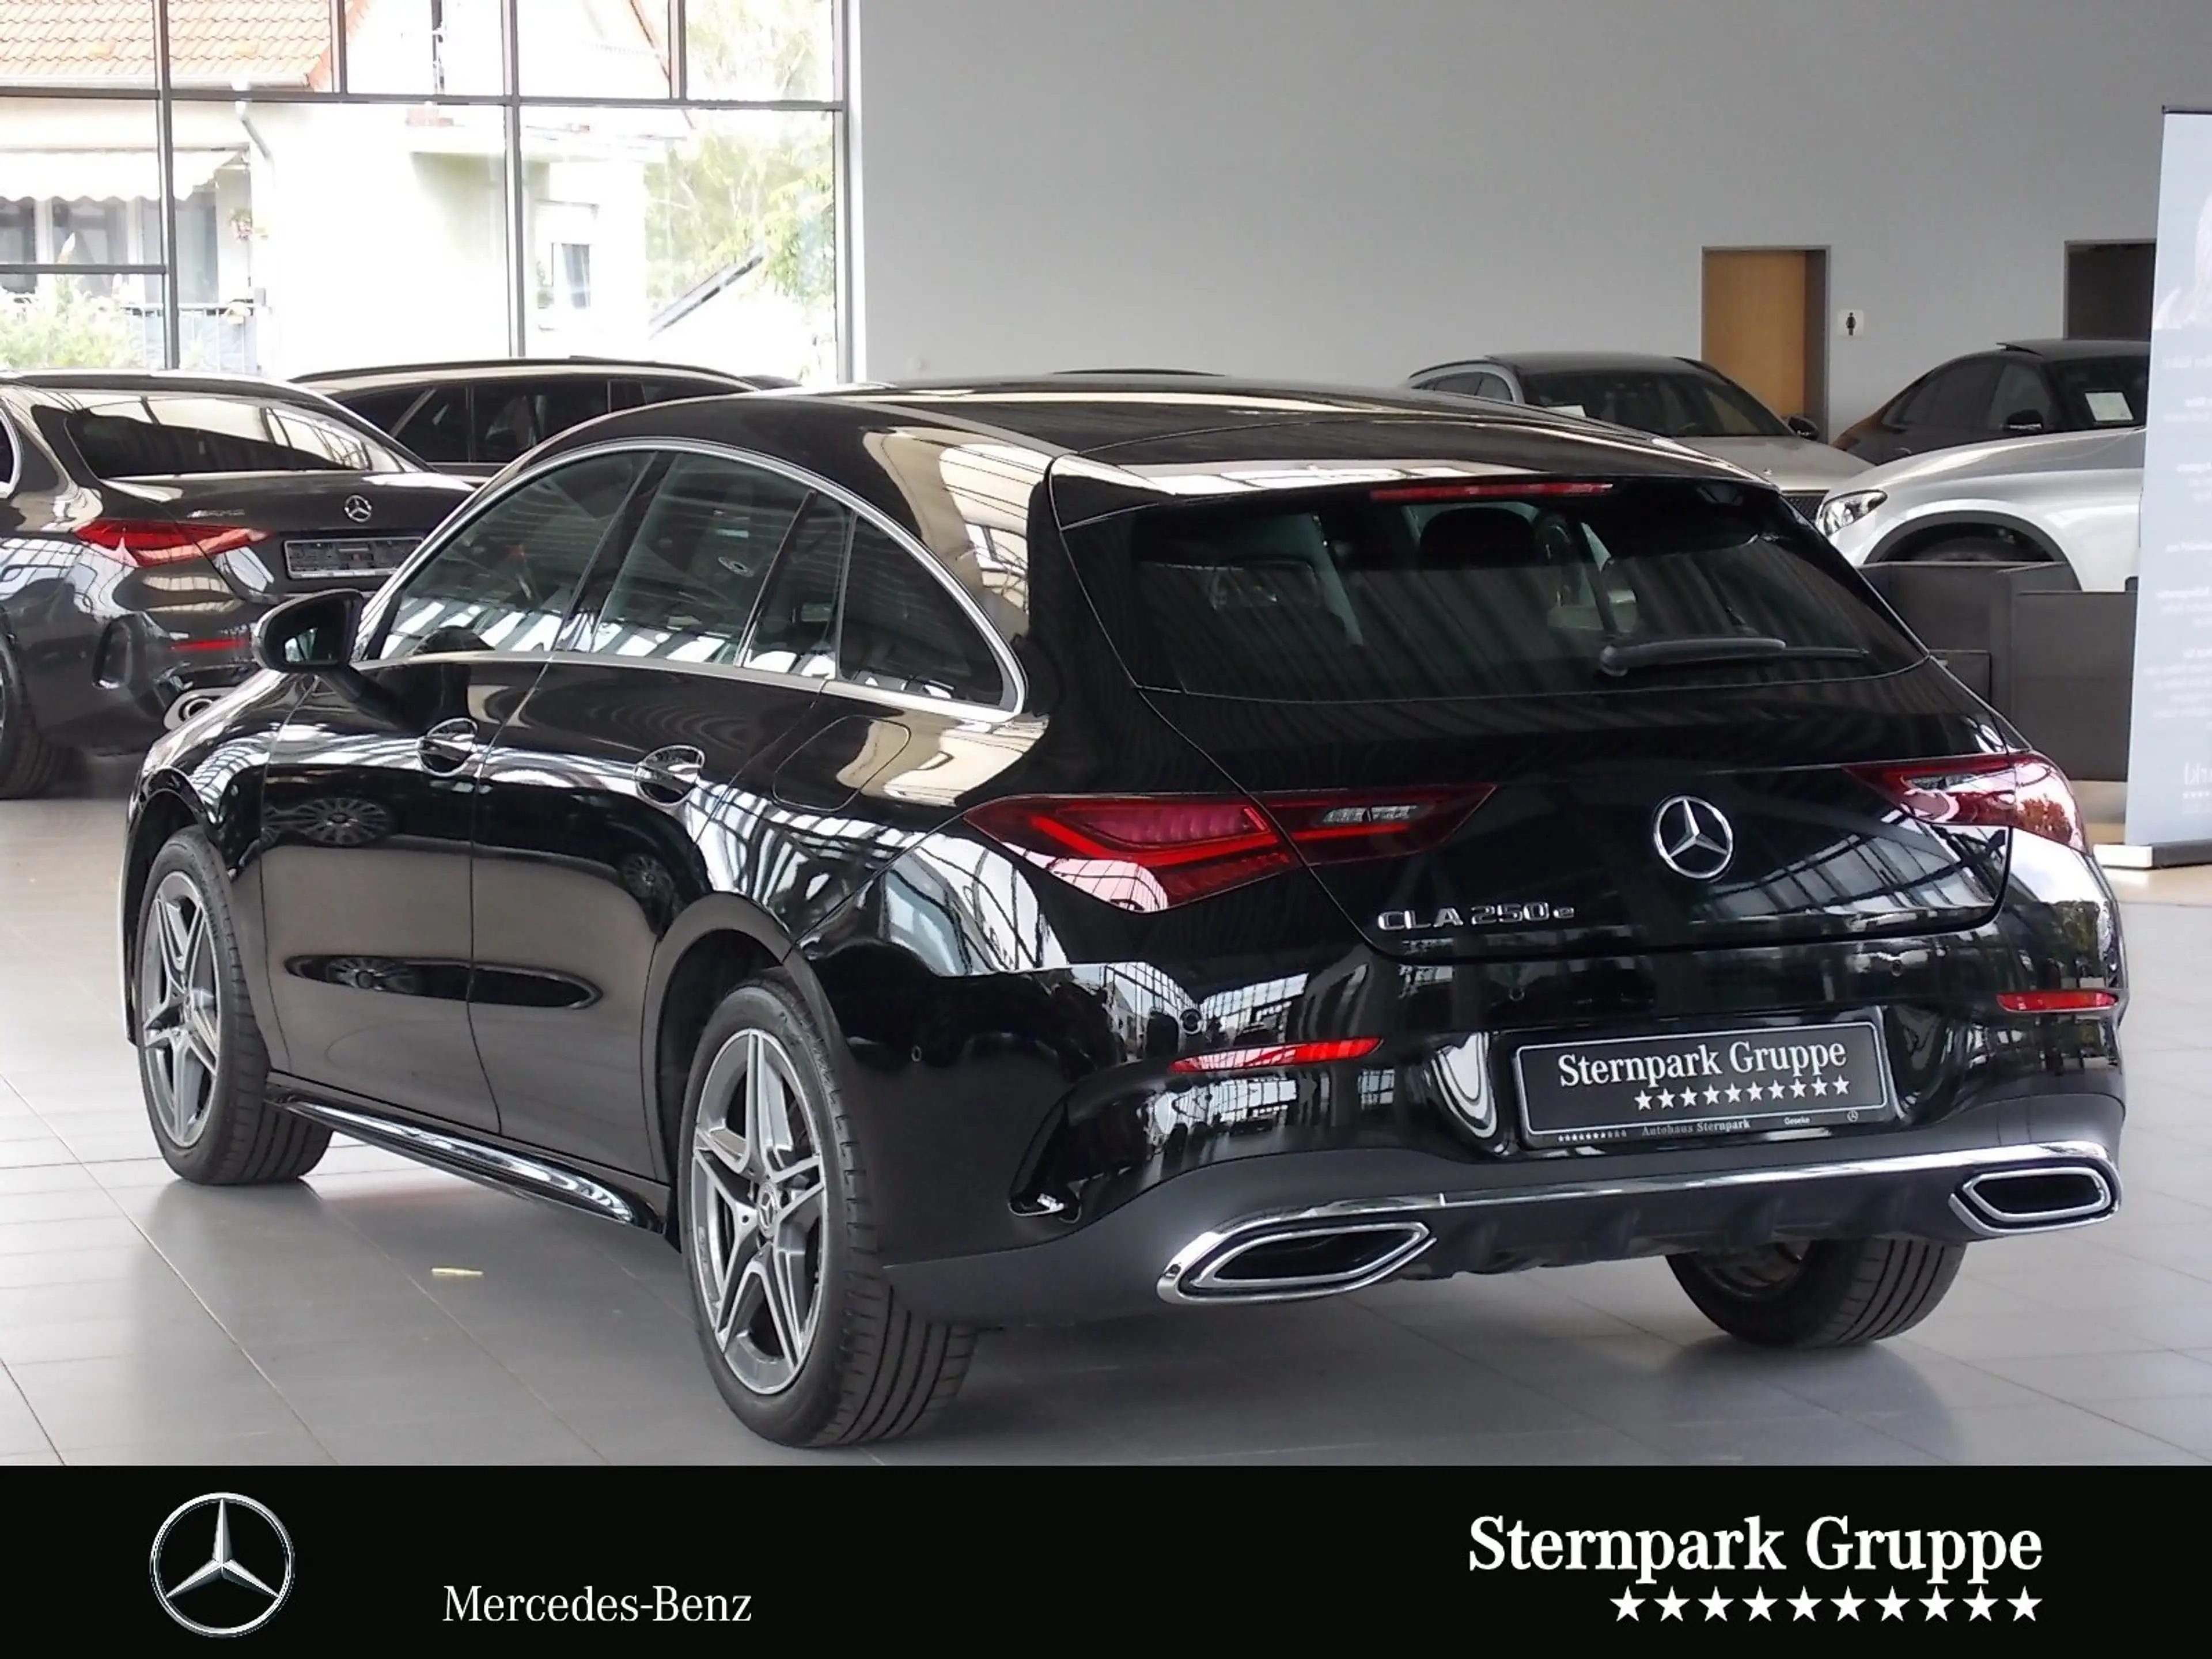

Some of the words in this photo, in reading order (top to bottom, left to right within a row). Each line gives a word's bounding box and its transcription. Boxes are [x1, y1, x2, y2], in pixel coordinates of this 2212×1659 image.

[1377, 907, 1464, 930] CLA
[1558, 1043, 1723, 1088] Sternpark
[1729, 1040, 1847, 1077] Gruppe
[1642, 1124, 1694, 1137] Autohaus
[1696, 1118, 1751, 1132] Sternpark
